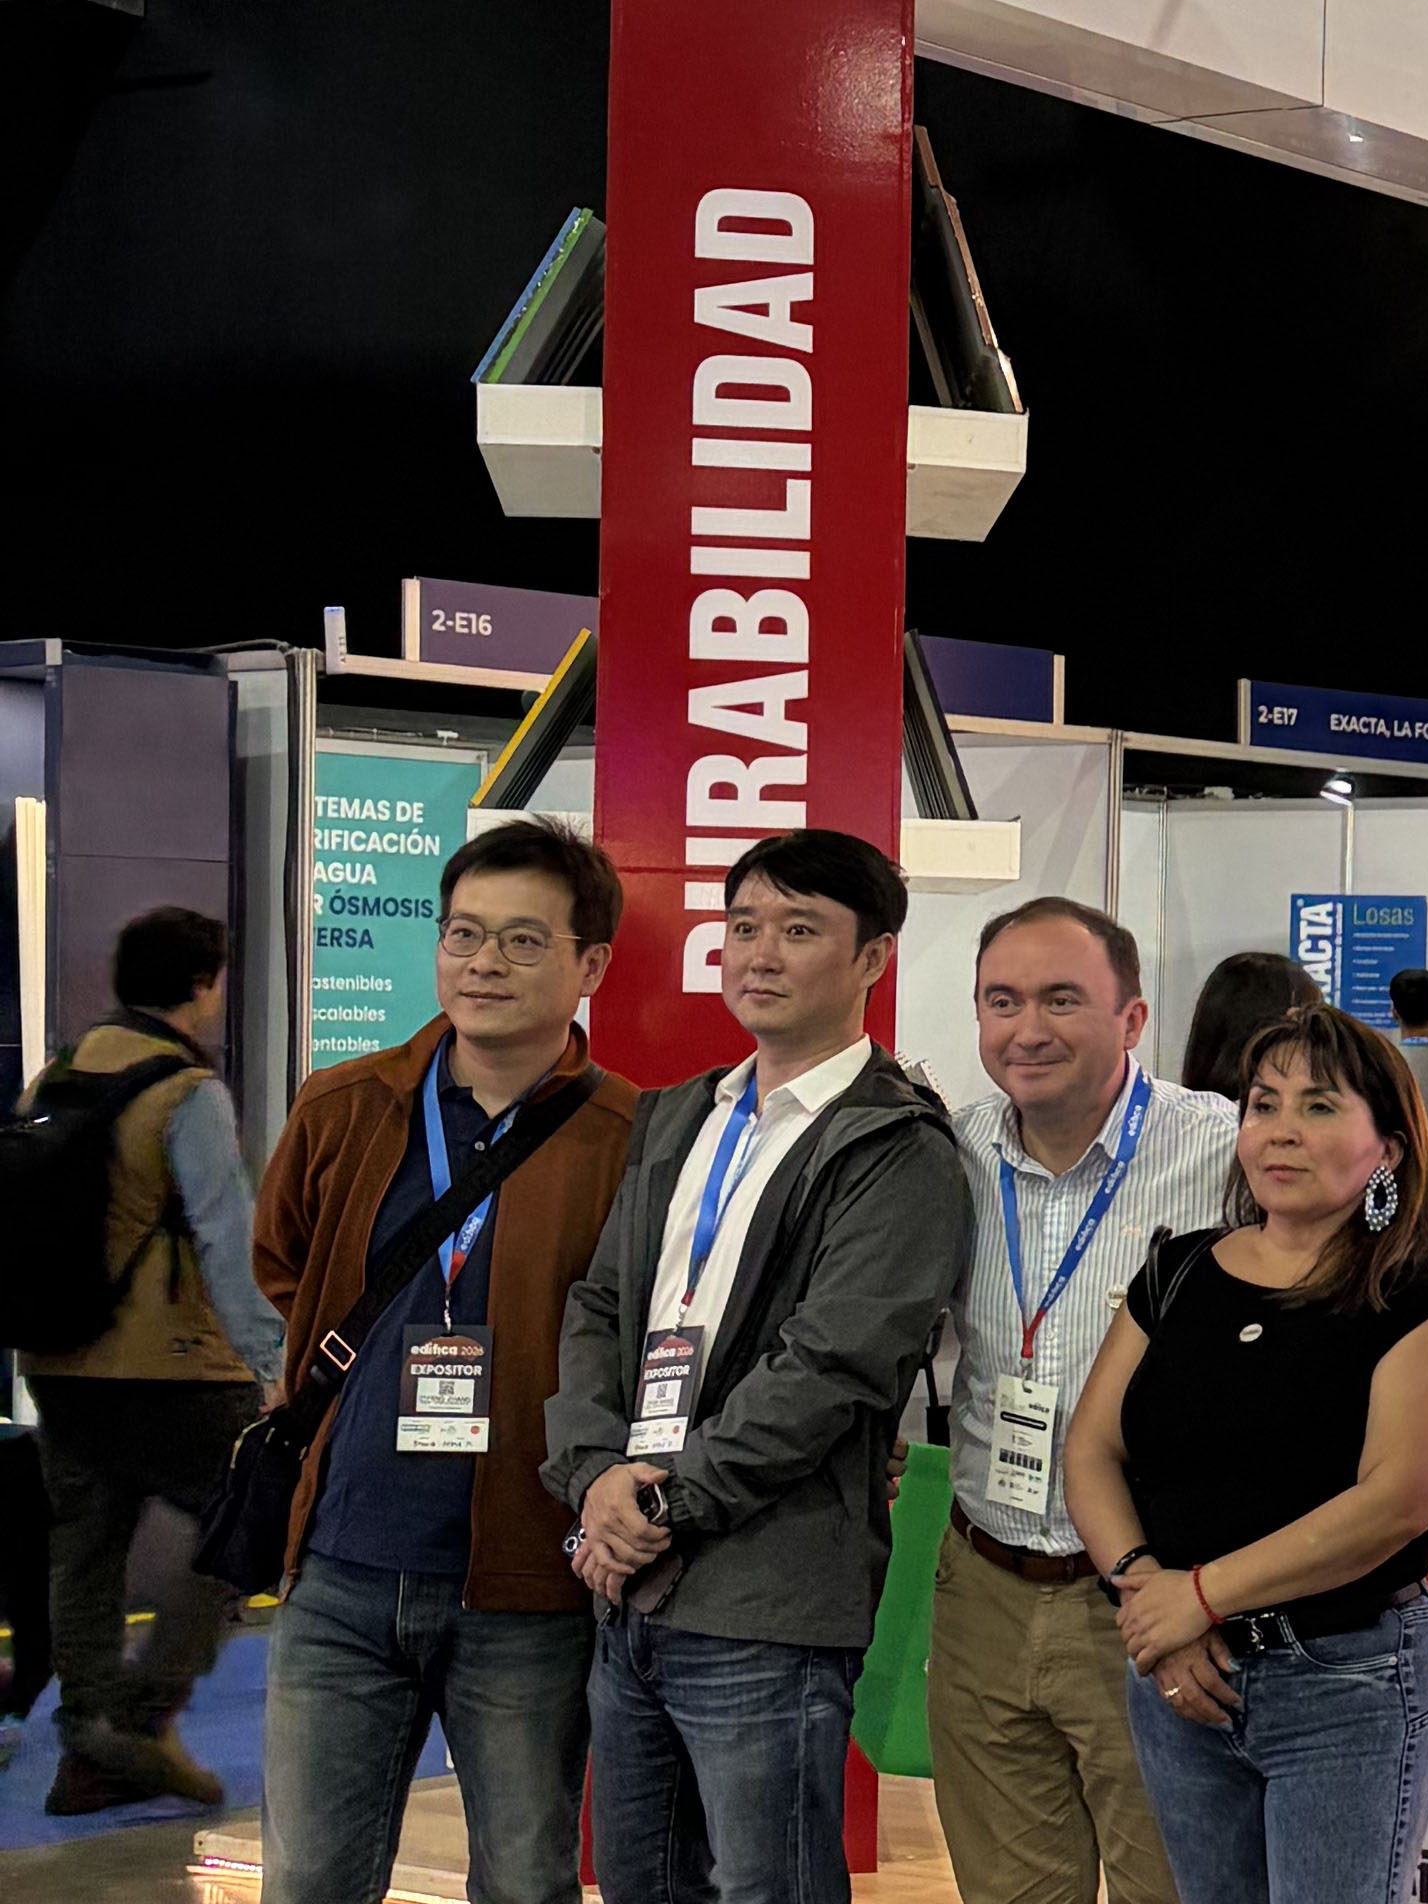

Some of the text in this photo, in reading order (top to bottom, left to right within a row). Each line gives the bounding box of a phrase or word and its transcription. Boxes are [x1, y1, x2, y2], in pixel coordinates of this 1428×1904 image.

[431, 609, 493, 636] 2-E16
[1257, 705, 1298, 726] 2-E17
[1330, 713, 1390, 738] EXACTA,
[1393, 719, 1412, 738] LA
[396, 800, 425, 824] DE
[313, 861, 377, 885] AGUA
[329, 888, 434, 919] ÓSMOSIS
[1352, 901, 1415, 926] Losas
[314, 927, 374, 950] ERSA
[411, 1364, 483, 1376] EXPOSITOR
